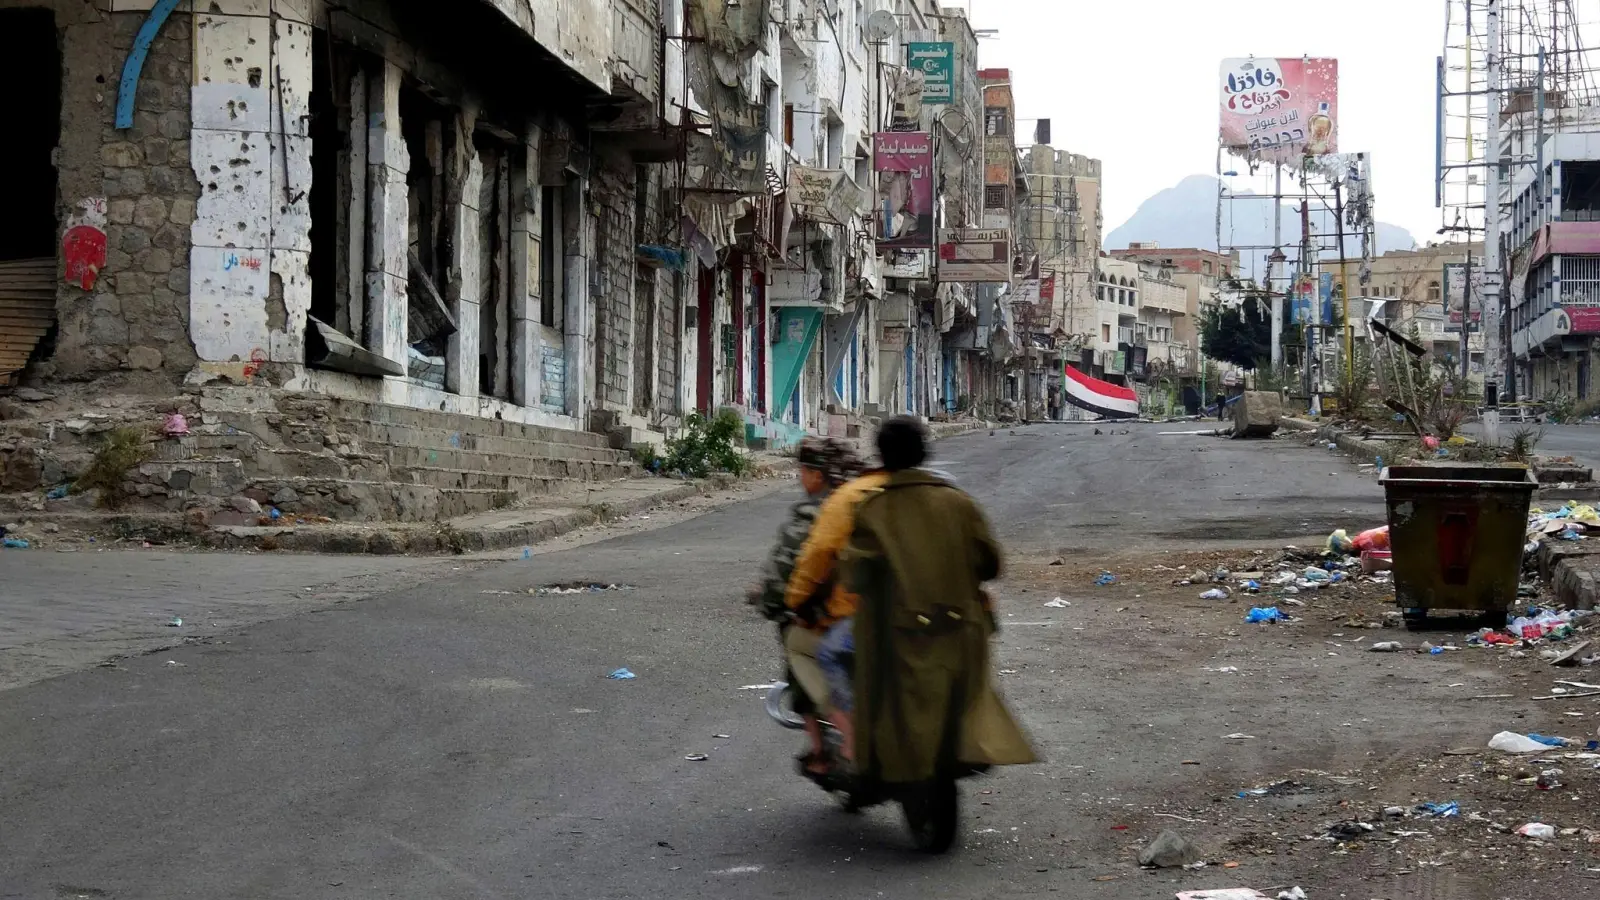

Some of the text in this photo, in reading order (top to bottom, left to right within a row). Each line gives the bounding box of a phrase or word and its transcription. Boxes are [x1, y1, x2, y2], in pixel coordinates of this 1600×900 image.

[911, 44, 948, 60] مختبر
[1228, 68, 1275, 92] فانتا
[1240, 92, 1270, 109] تفاح
[1245, 117, 1276, 130] عبوات
[877, 136, 929, 158] صيدلية
